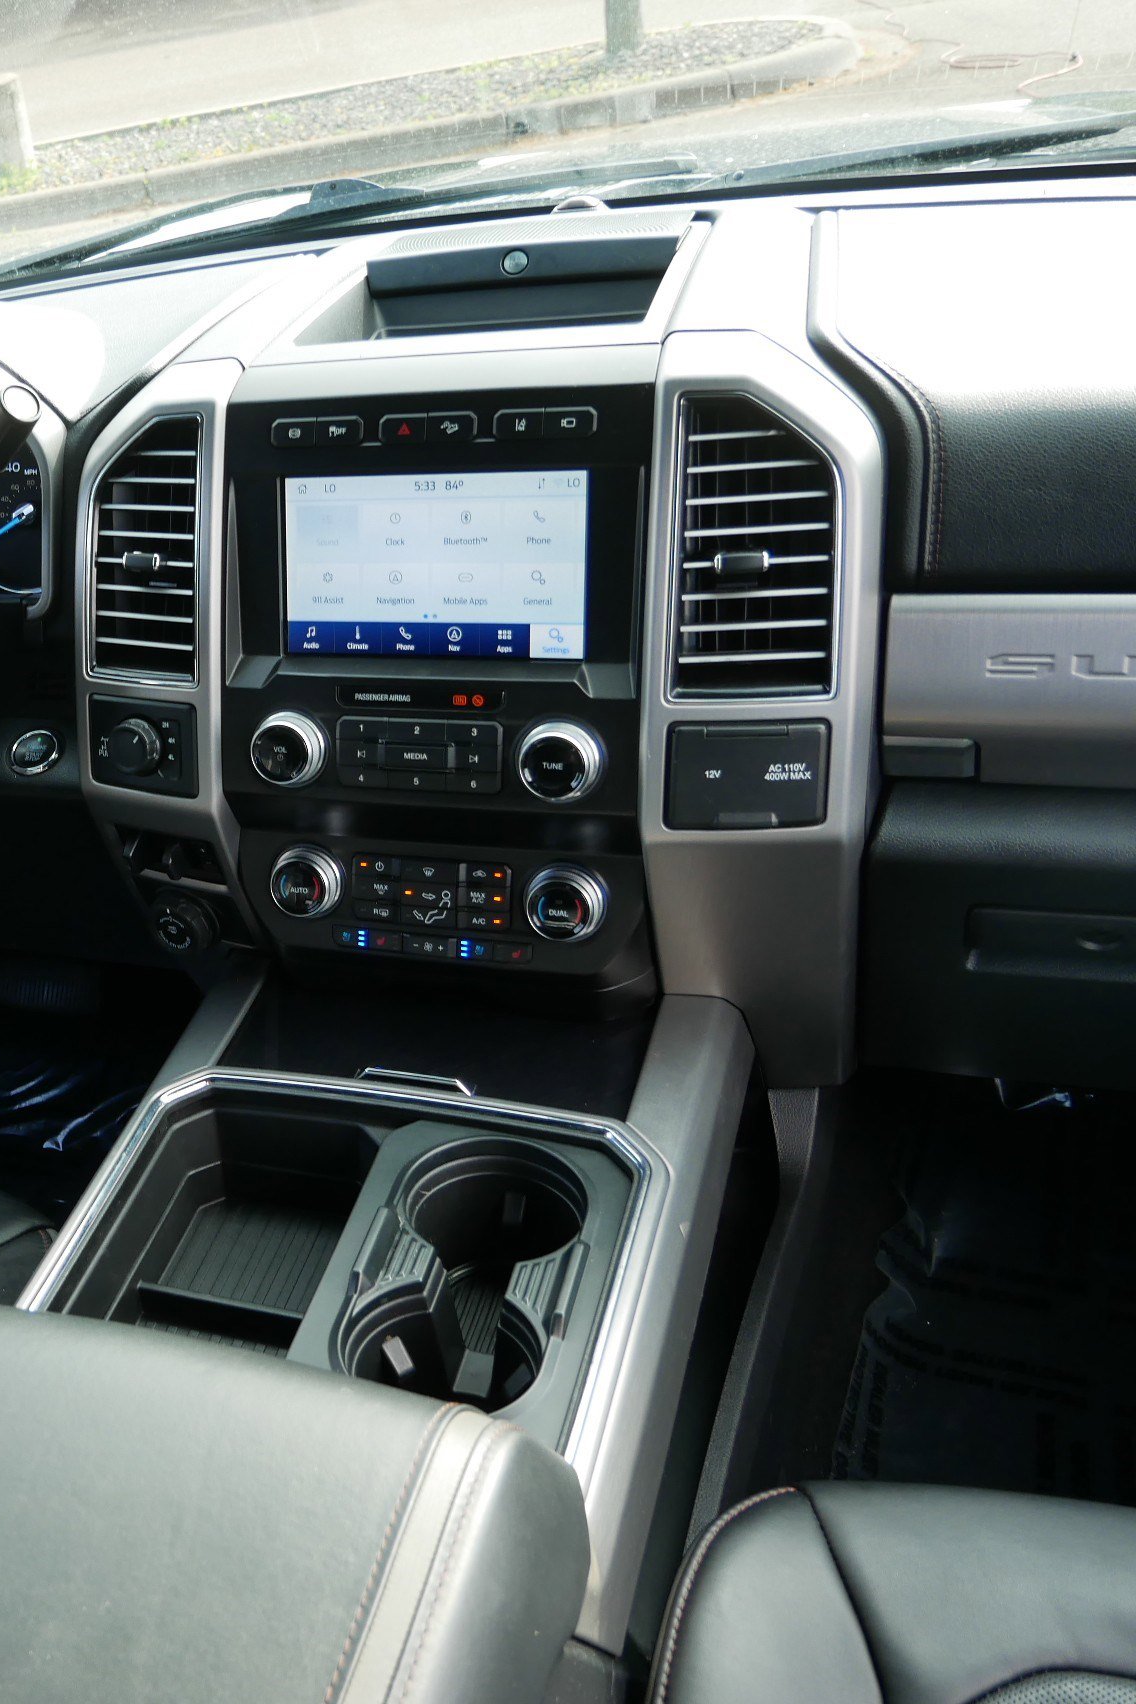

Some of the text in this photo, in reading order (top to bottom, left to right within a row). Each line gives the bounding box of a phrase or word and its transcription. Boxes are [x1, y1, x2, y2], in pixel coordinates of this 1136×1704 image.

[5, 461, 21, 473] 40
[24, 468, 38, 476] MPH
[414, 481, 436, 491] 5:33
[567, 477, 581, 488] LO
[324, 483, 336, 493] LO
[385, 538, 405, 546] Clock
[526, 536, 552, 545] Phone
[312, 596, 344, 604] 911 Assist
[376, 597, 415, 606] Navigation
[443, 597, 488, 606] Mobile Apps
[523, 597, 553, 606] General
[346, 642, 369, 650] Climate
[396, 643, 415, 651] Phone
[448, 644, 461, 652] Nav
[496, 645, 513, 654] Apps
[542, 646, 570, 655] Settings
[354, 693, 411, 702] PASSENGER AIRBAG
[359, 724, 364, 732] 1
[414, 726, 420, 735] 2
[471, 728, 477, 736] 3
[403, 752, 428, 760] MEDIA
[542, 762, 564, 771] TUNE
[768, 763, 806, 773] AC 110V
[358, 774, 364, 782] 4
[704, 770, 721, 779] 12V
[764, 771, 811, 781] 400W MAX
[413, 777, 419, 785] 5
[470, 780, 477, 789] 6
[373, 883, 388, 891] MAX
[470, 891, 486, 899] MAX
[548, 909, 569, 918] DUAL
